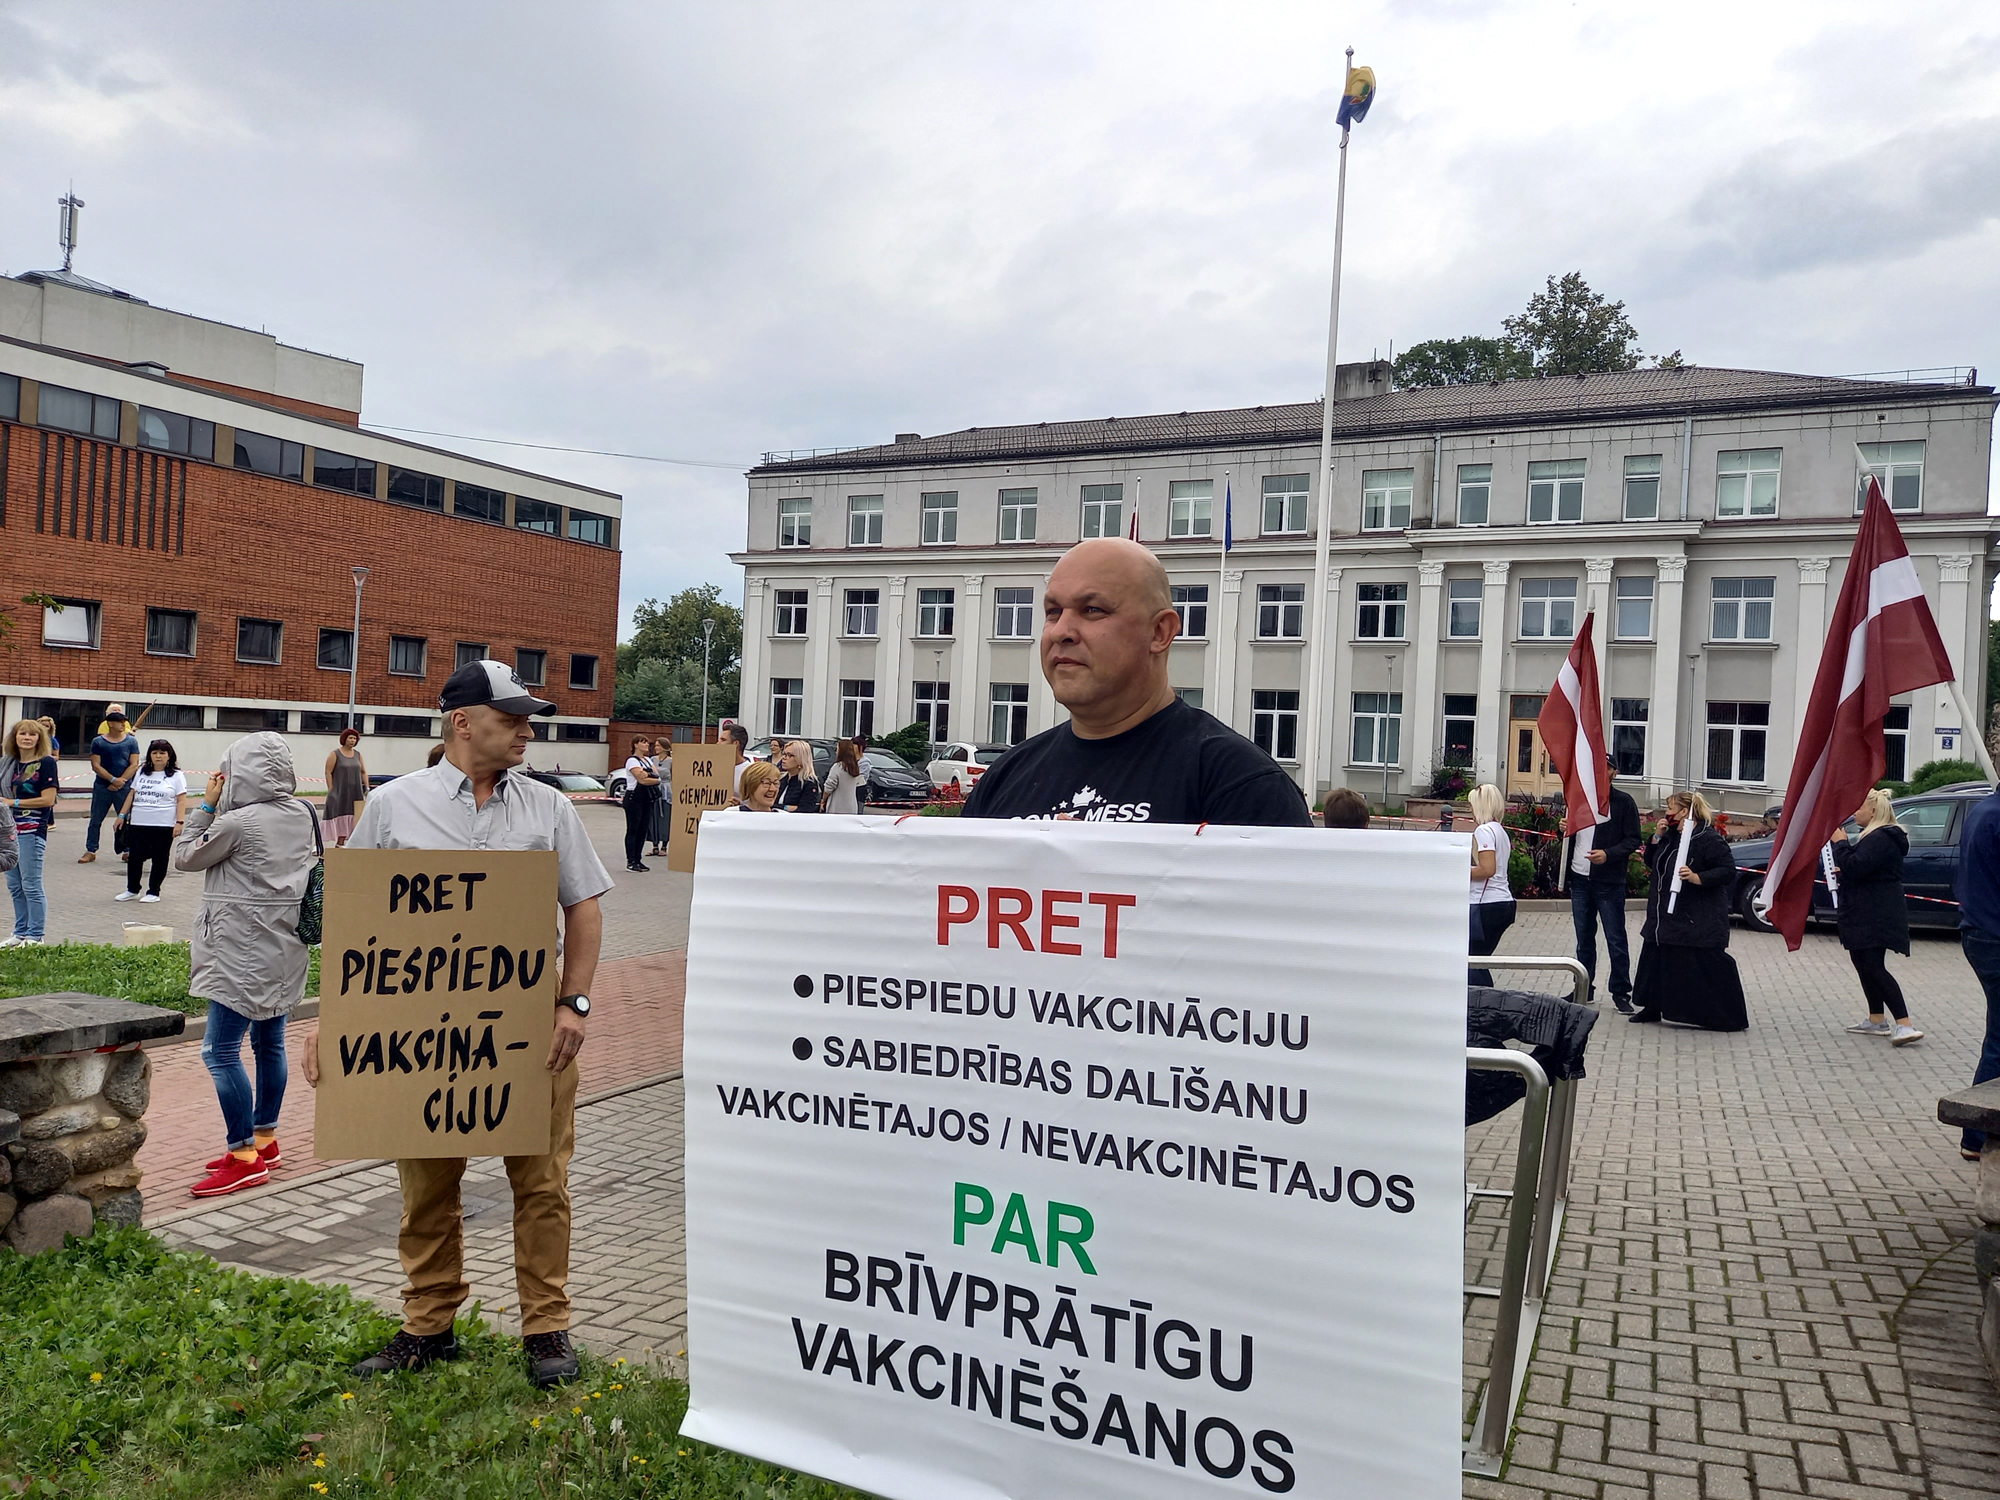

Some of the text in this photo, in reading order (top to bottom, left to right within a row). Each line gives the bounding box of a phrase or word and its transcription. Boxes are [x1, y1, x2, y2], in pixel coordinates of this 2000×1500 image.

[679, 784, 728, 808] CIEŅPILNU
[692, 760, 713, 777] PAR
[1084, 802, 1151, 822] MESS
[390, 872, 487, 915] PRET
[937, 884, 1137, 959] PRET
[341, 933, 546, 997] PIESPIEDU
[823, 973, 1309, 1051] PIESPIEDU VAKCINĀCIJU
[423, 1072, 512, 1135] CIJU
[823, 1035, 1308, 1126] SABIEDRĪBAS DALĪŠANU
[716, 1084, 1415, 1214] VAKCINĒTAJOS / NEVAKCINĒTAJOS
[953, 1181, 1099, 1276] PAR
[825, 1248, 1254, 1392] BRĪVPRĀTĪGU
[791, 1316, 1296, 1494] VAKCINĒŠANOS
